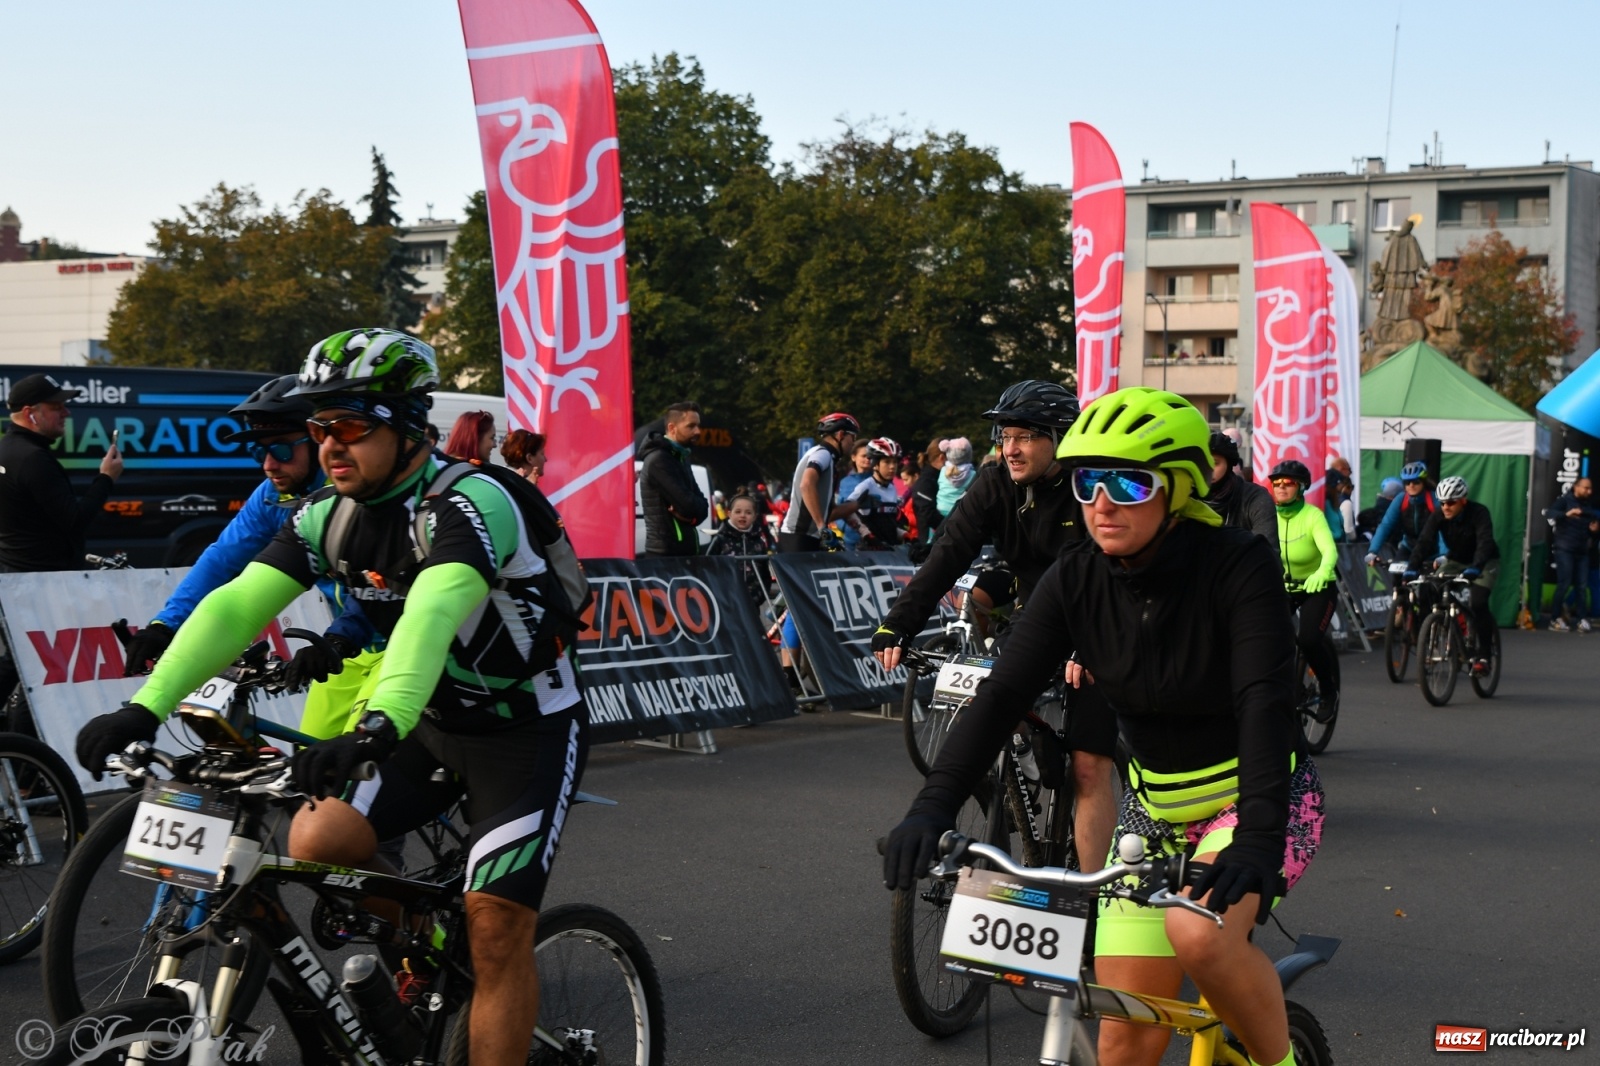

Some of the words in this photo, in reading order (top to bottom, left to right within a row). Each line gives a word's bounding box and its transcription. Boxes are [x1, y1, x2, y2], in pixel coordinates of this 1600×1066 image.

[633, 673, 745, 717] NAJLEPSZYCH
[138, 815, 207, 855] 2154
[322, 873, 368, 890] SIX
[969, 913, 1060, 961] 3088
